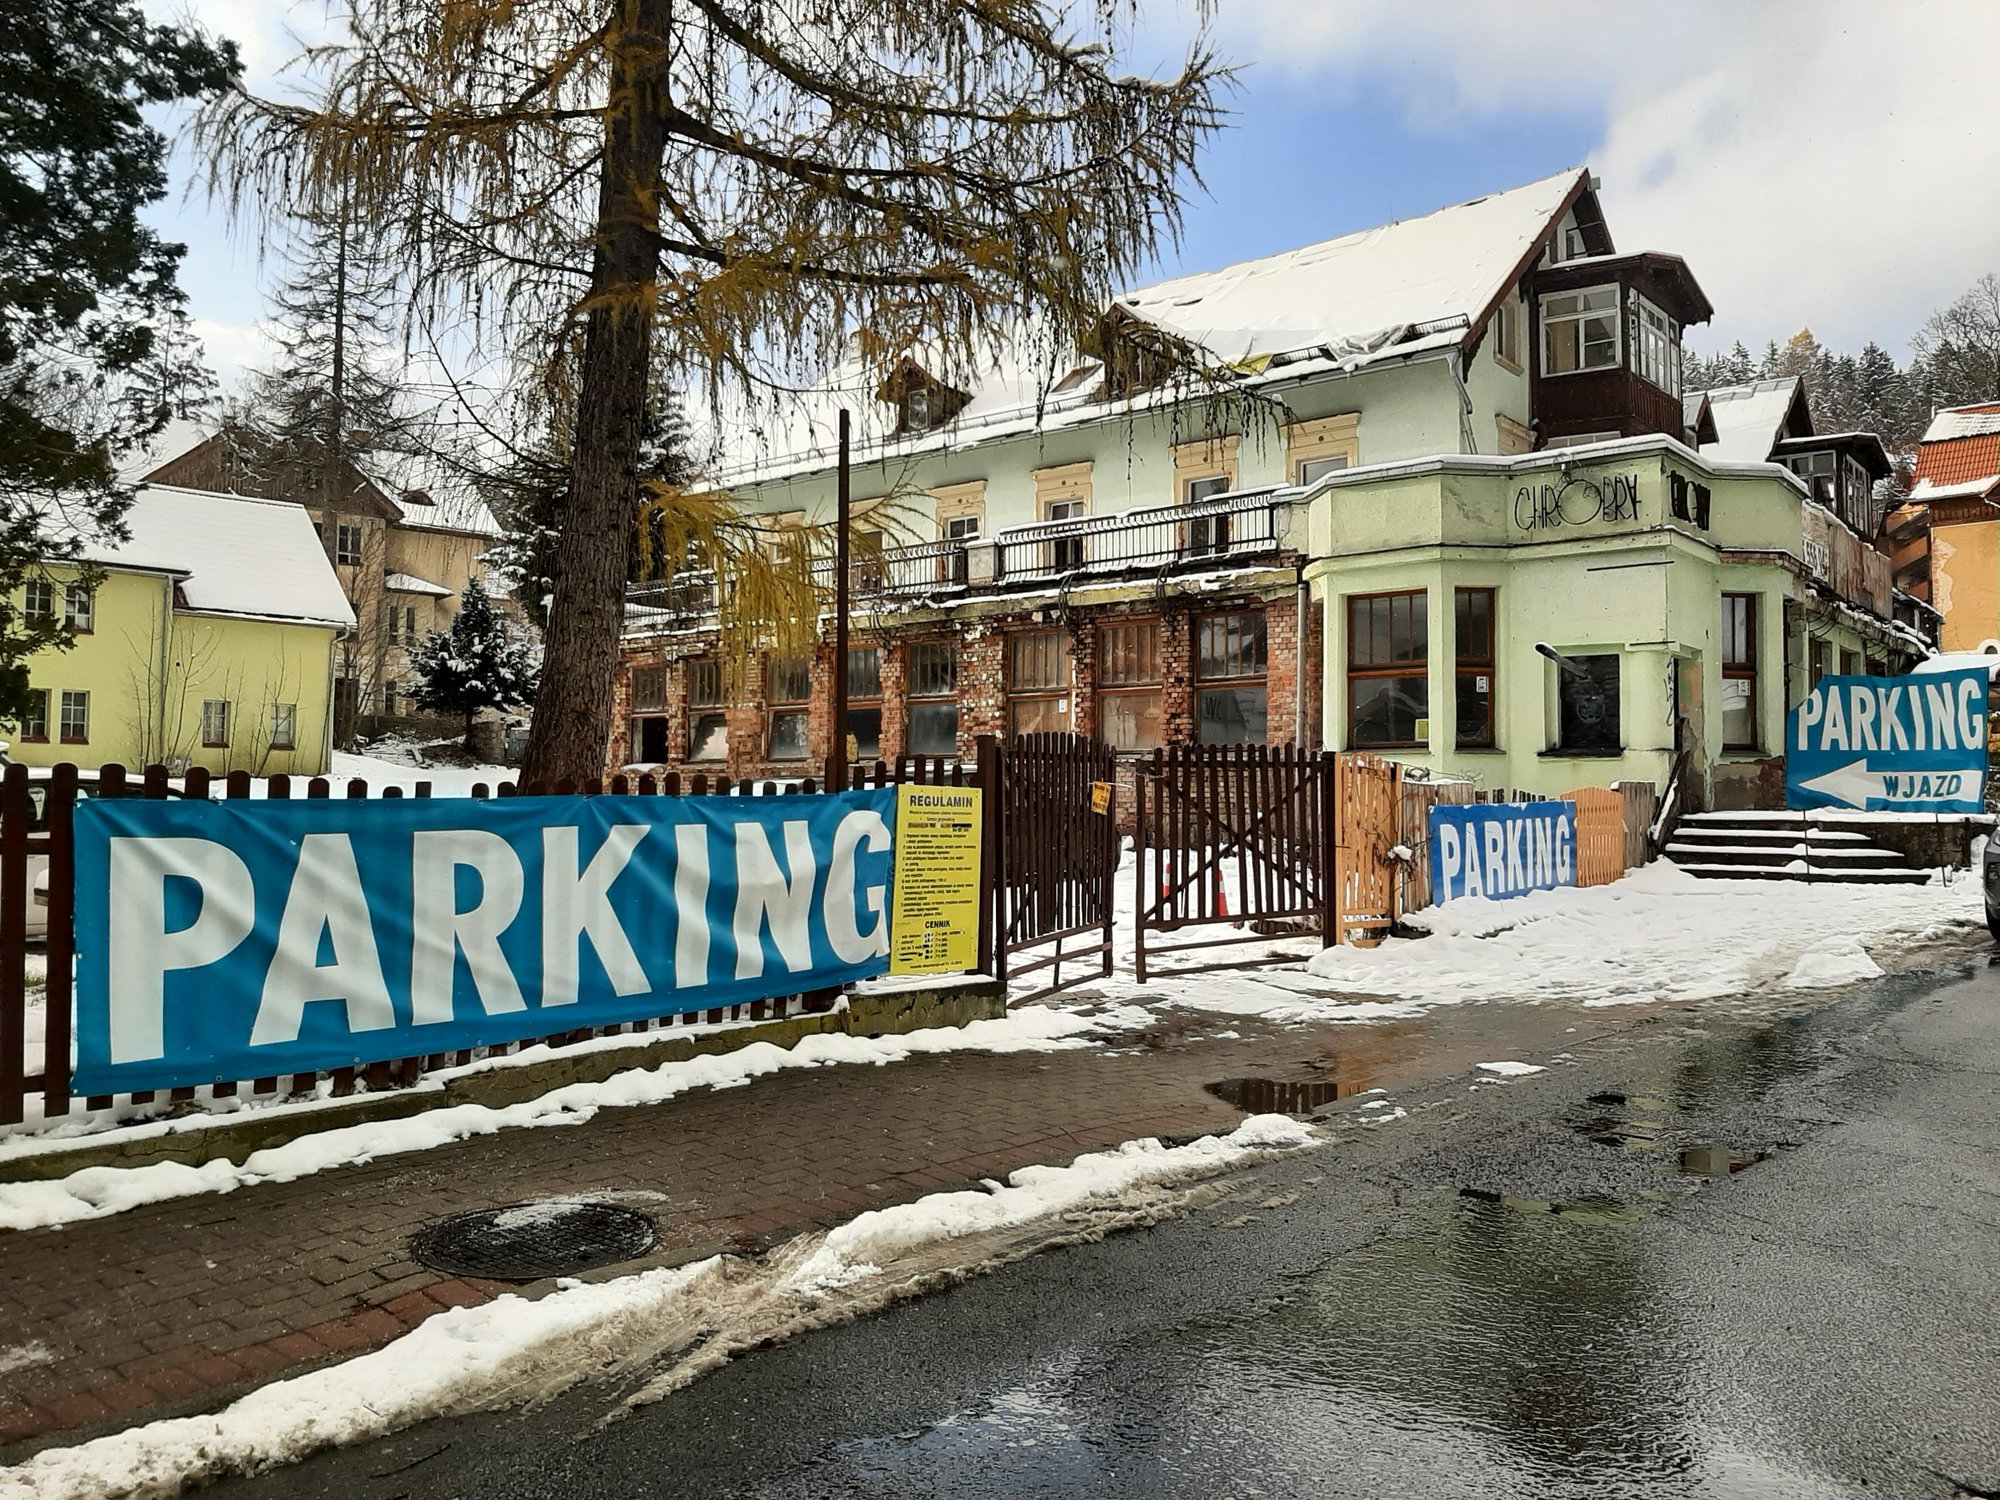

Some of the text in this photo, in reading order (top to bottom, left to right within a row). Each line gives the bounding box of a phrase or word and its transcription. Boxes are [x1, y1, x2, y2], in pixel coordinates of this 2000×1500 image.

[1514, 474, 1641, 530] CHROBRY
[1798, 678, 1984, 751] PARKING
[909, 794, 973, 807] REGULAMIN
[1882, 774, 1962, 798] WJAZD
[1439, 814, 1571, 900] PARKING
[109, 810, 891, 1065] PARKING
[924, 920, 951, 929] CENNIK
